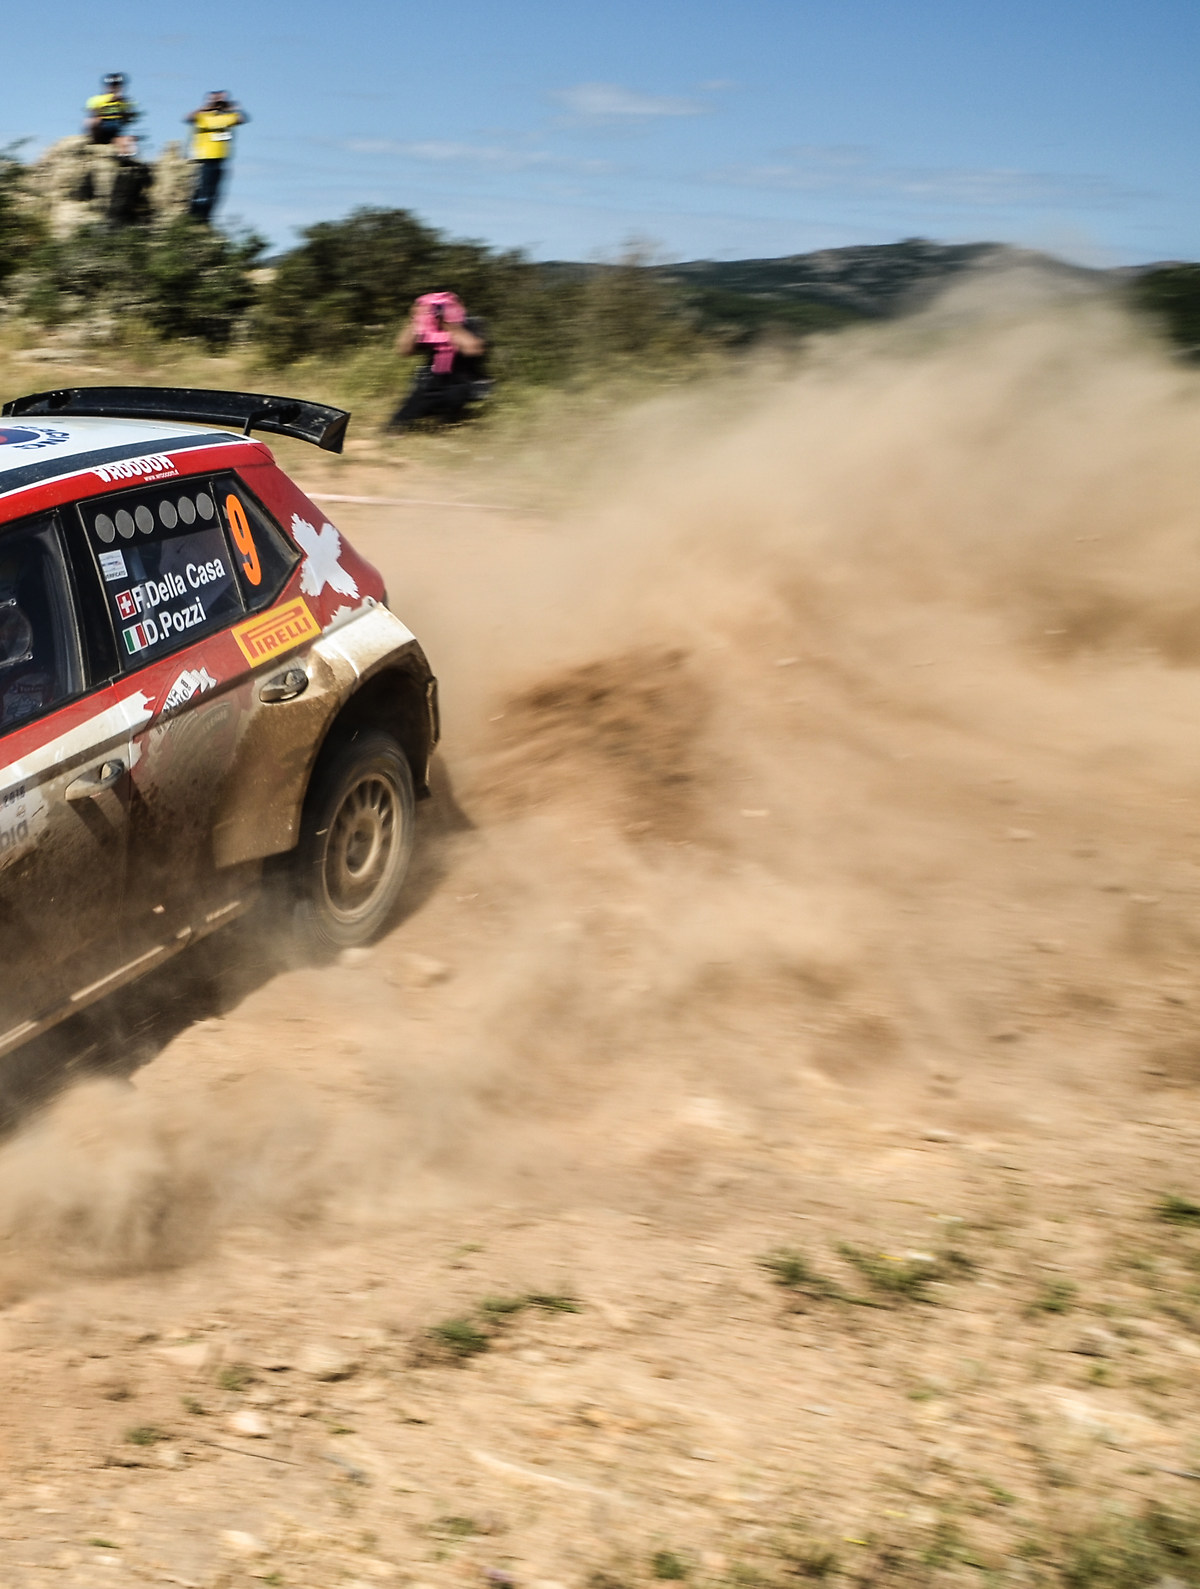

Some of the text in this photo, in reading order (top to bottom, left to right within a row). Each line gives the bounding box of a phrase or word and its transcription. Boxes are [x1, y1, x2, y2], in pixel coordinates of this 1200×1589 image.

[226, 494, 262, 586] 9
[131, 558, 226, 613] F.Della Casa
[142, 596, 207, 646] D.Pozzi
[240, 605, 313, 660] PIRELLI
